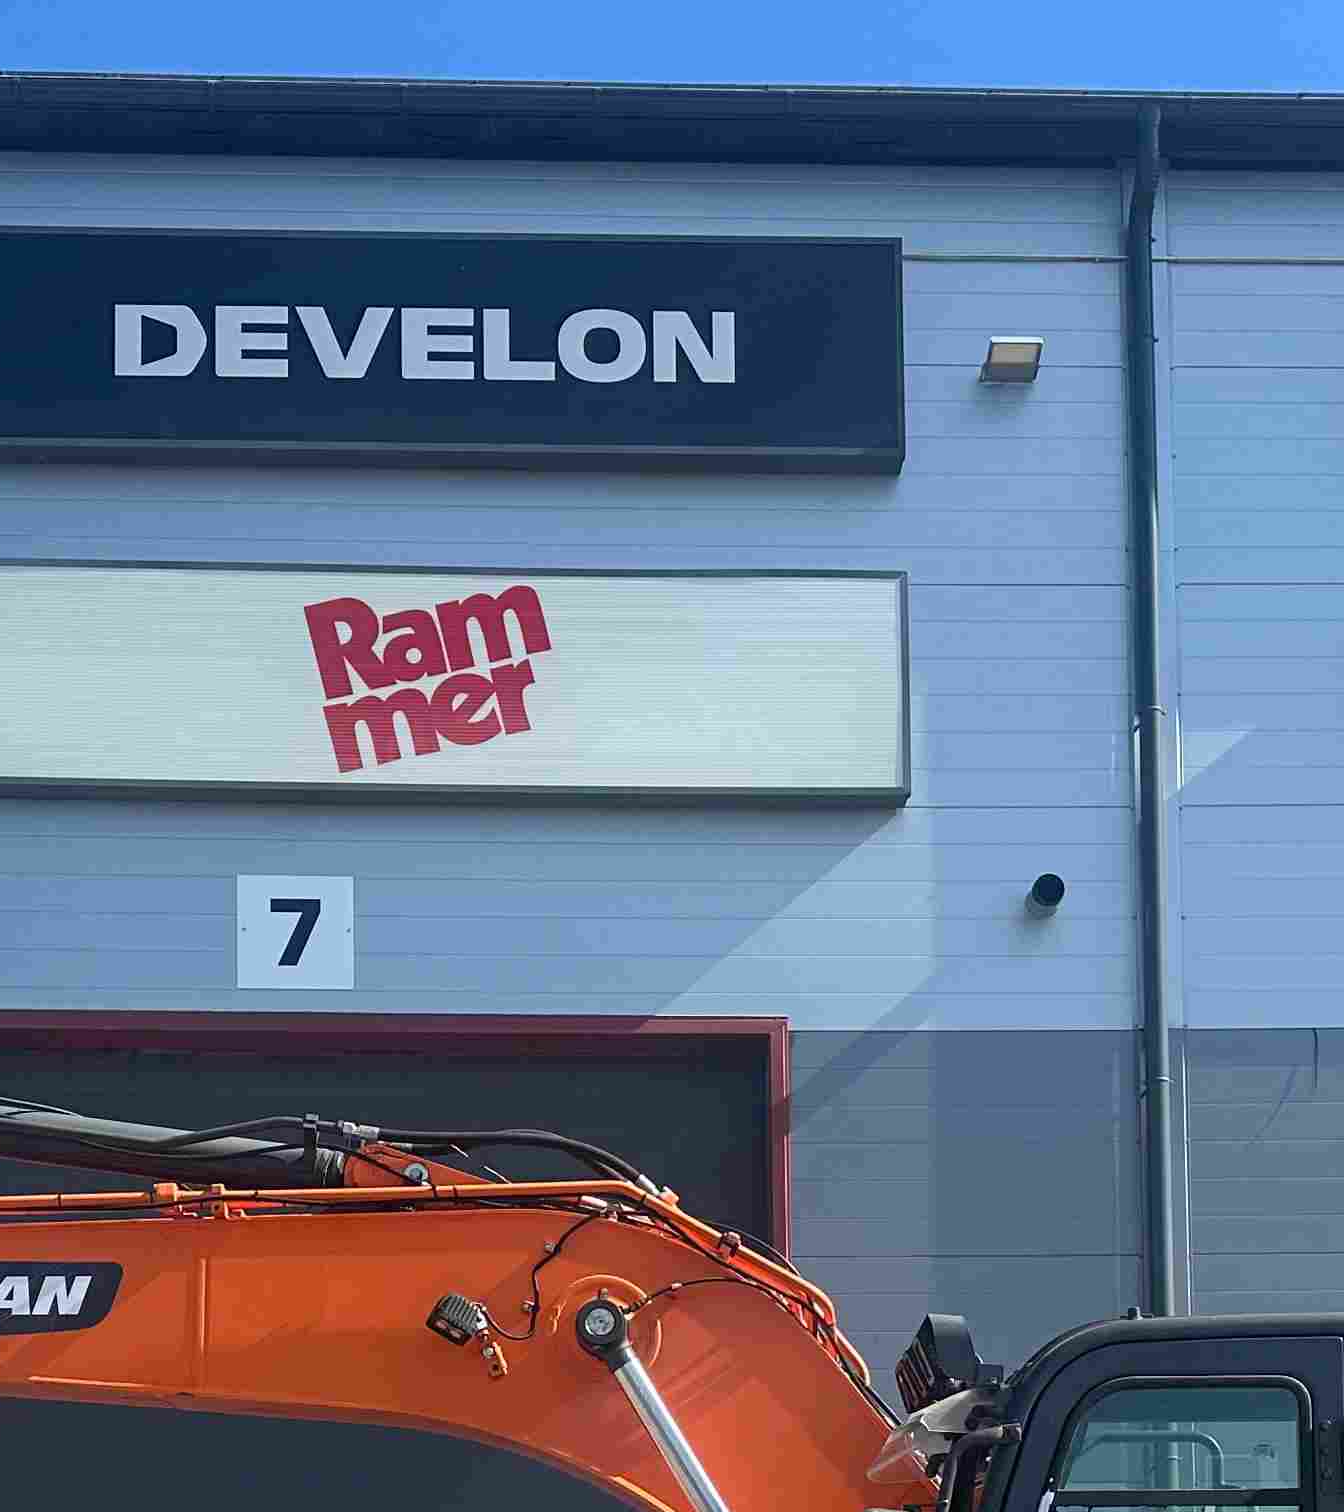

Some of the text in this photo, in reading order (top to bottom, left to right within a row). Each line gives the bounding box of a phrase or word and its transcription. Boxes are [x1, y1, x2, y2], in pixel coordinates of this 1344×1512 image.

[112, 302, 737, 385] DEVELON
[303, 583, 553, 700] Ram
[321, 657, 537, 775] mer
[267, 897, 322, 969] 7
